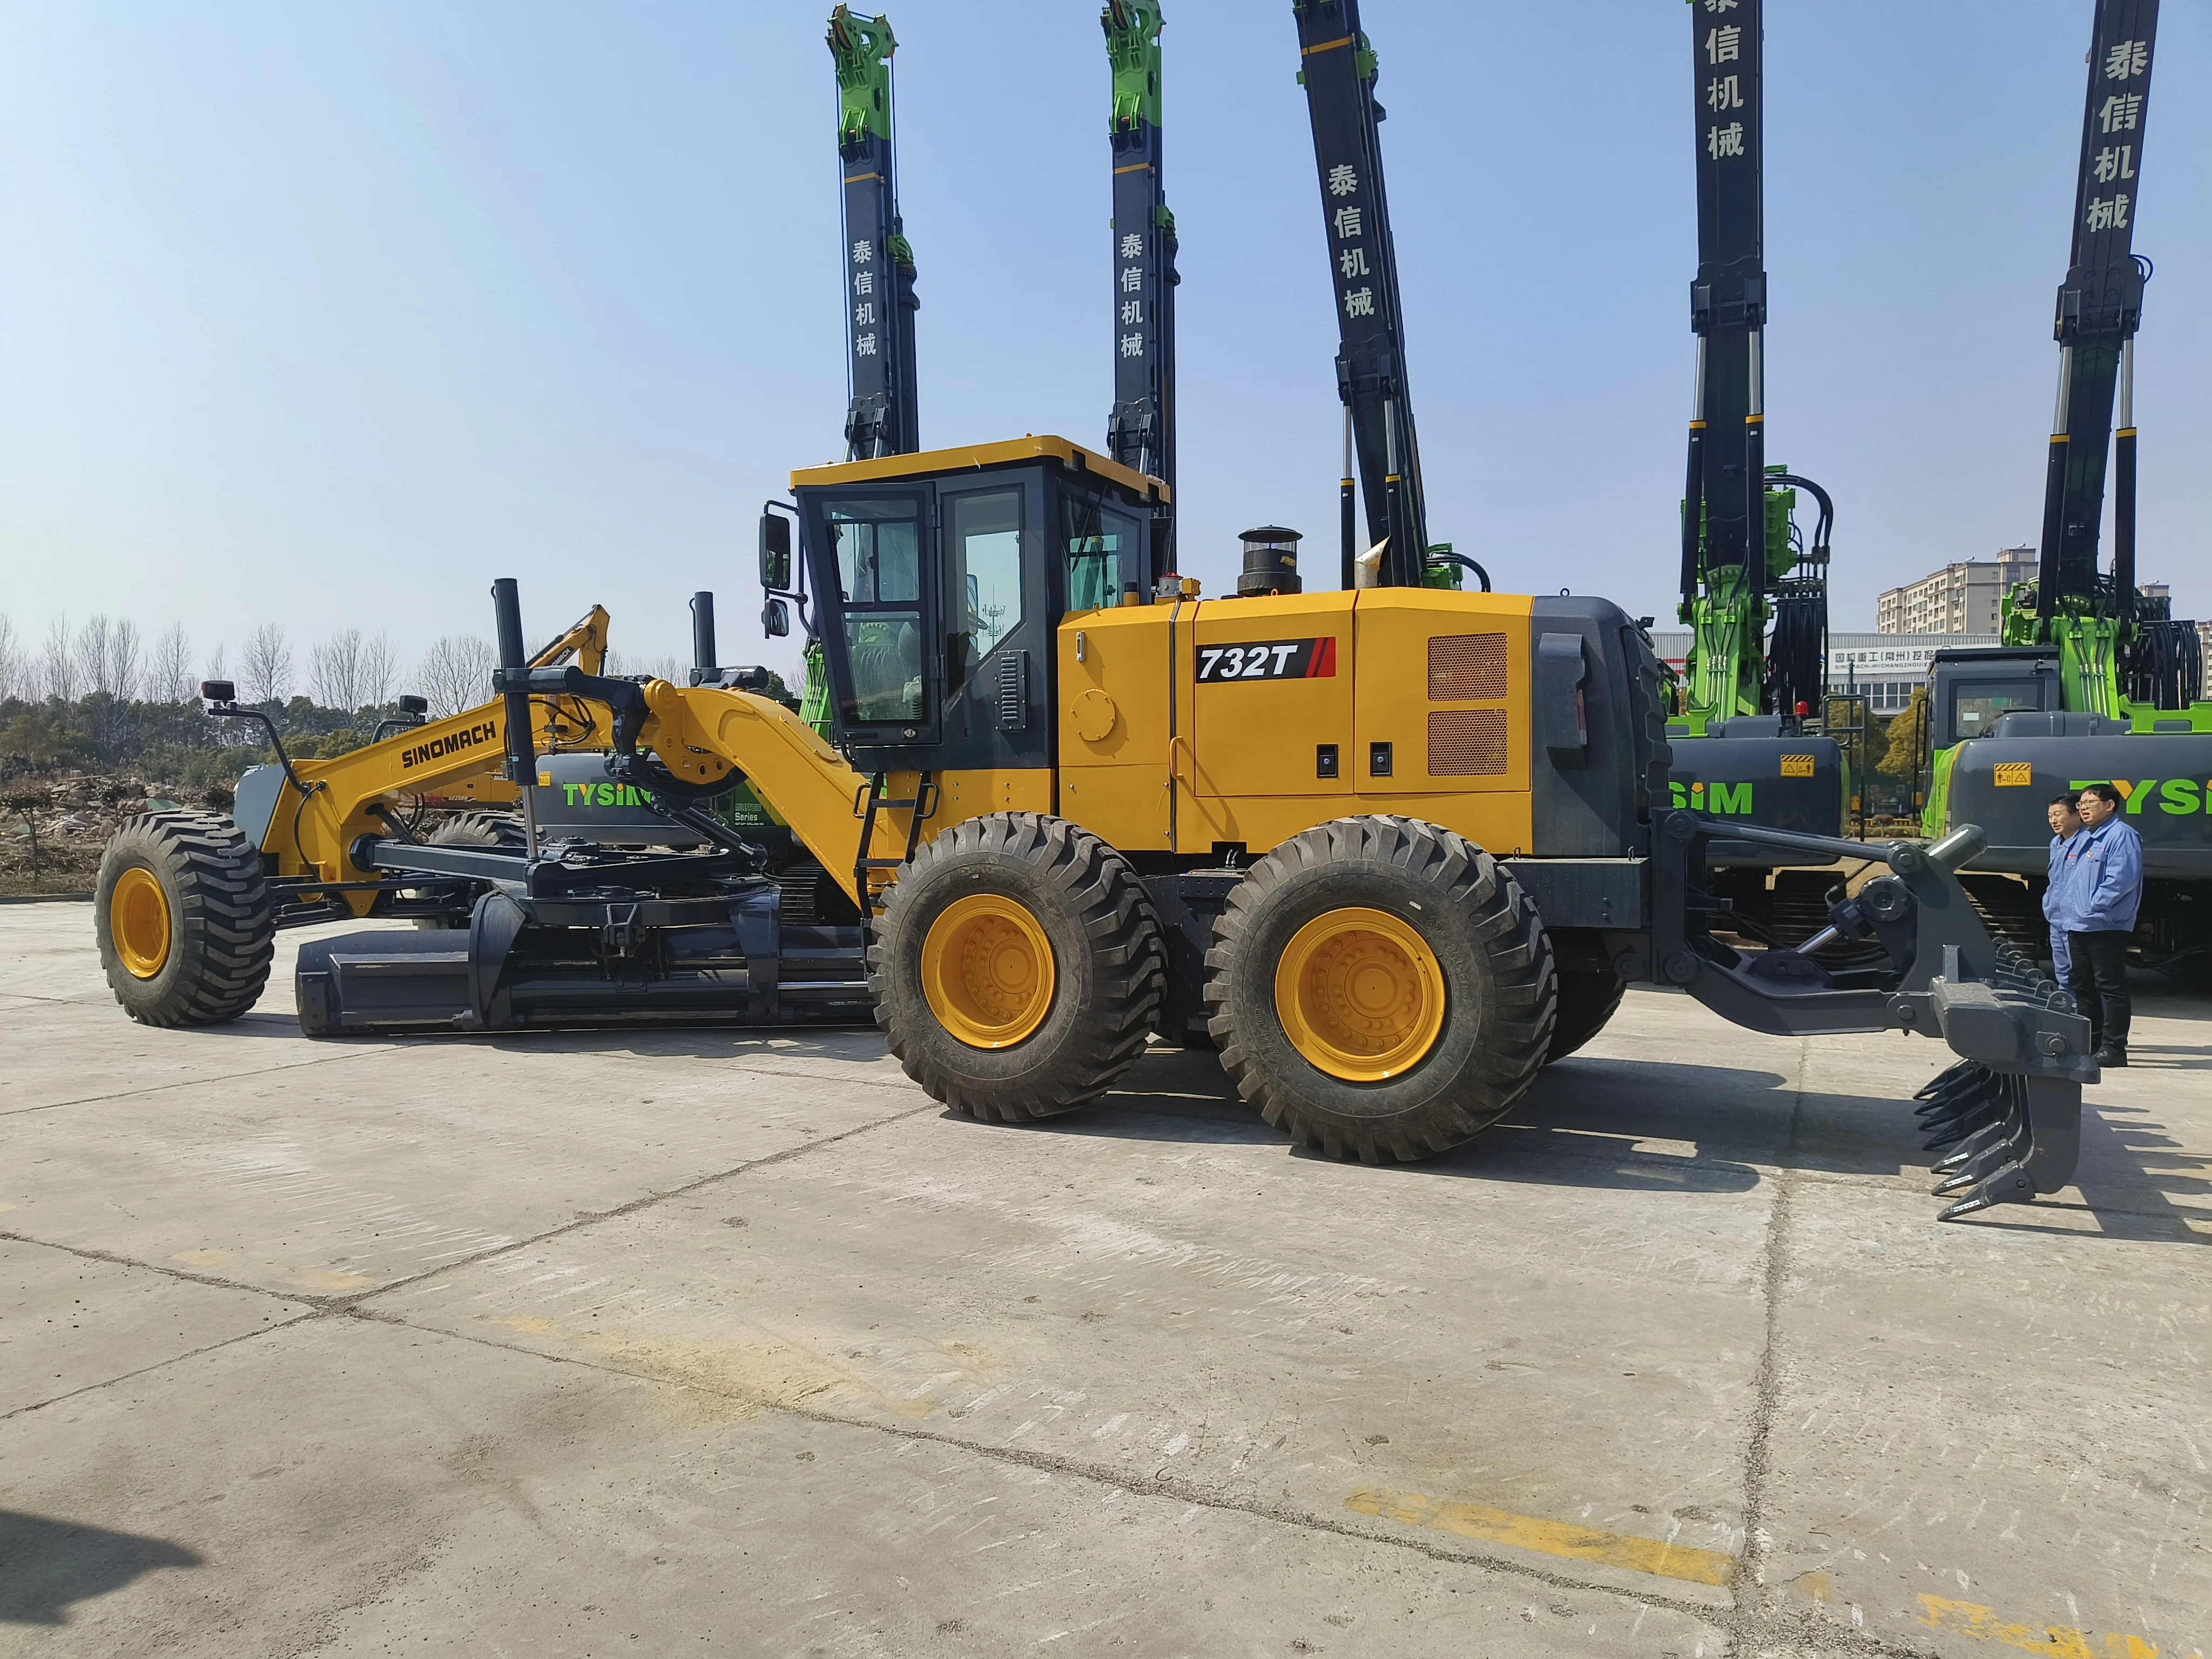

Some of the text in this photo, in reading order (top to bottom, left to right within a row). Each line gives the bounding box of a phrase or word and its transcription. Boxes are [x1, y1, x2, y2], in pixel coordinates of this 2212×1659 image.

[2086, 40, 2148, 233] 泰信机械
[853, 240, 876, 357] 泰信机械
[1121, 233, 1143, 358] 泰信机械
[1328, 164, 1374, 319] 泰信机械
[1199, 645, 1298, 679] 732T
[402, 721, 496, 768] SINOMACH
[735, 812, 758, 821] Series
